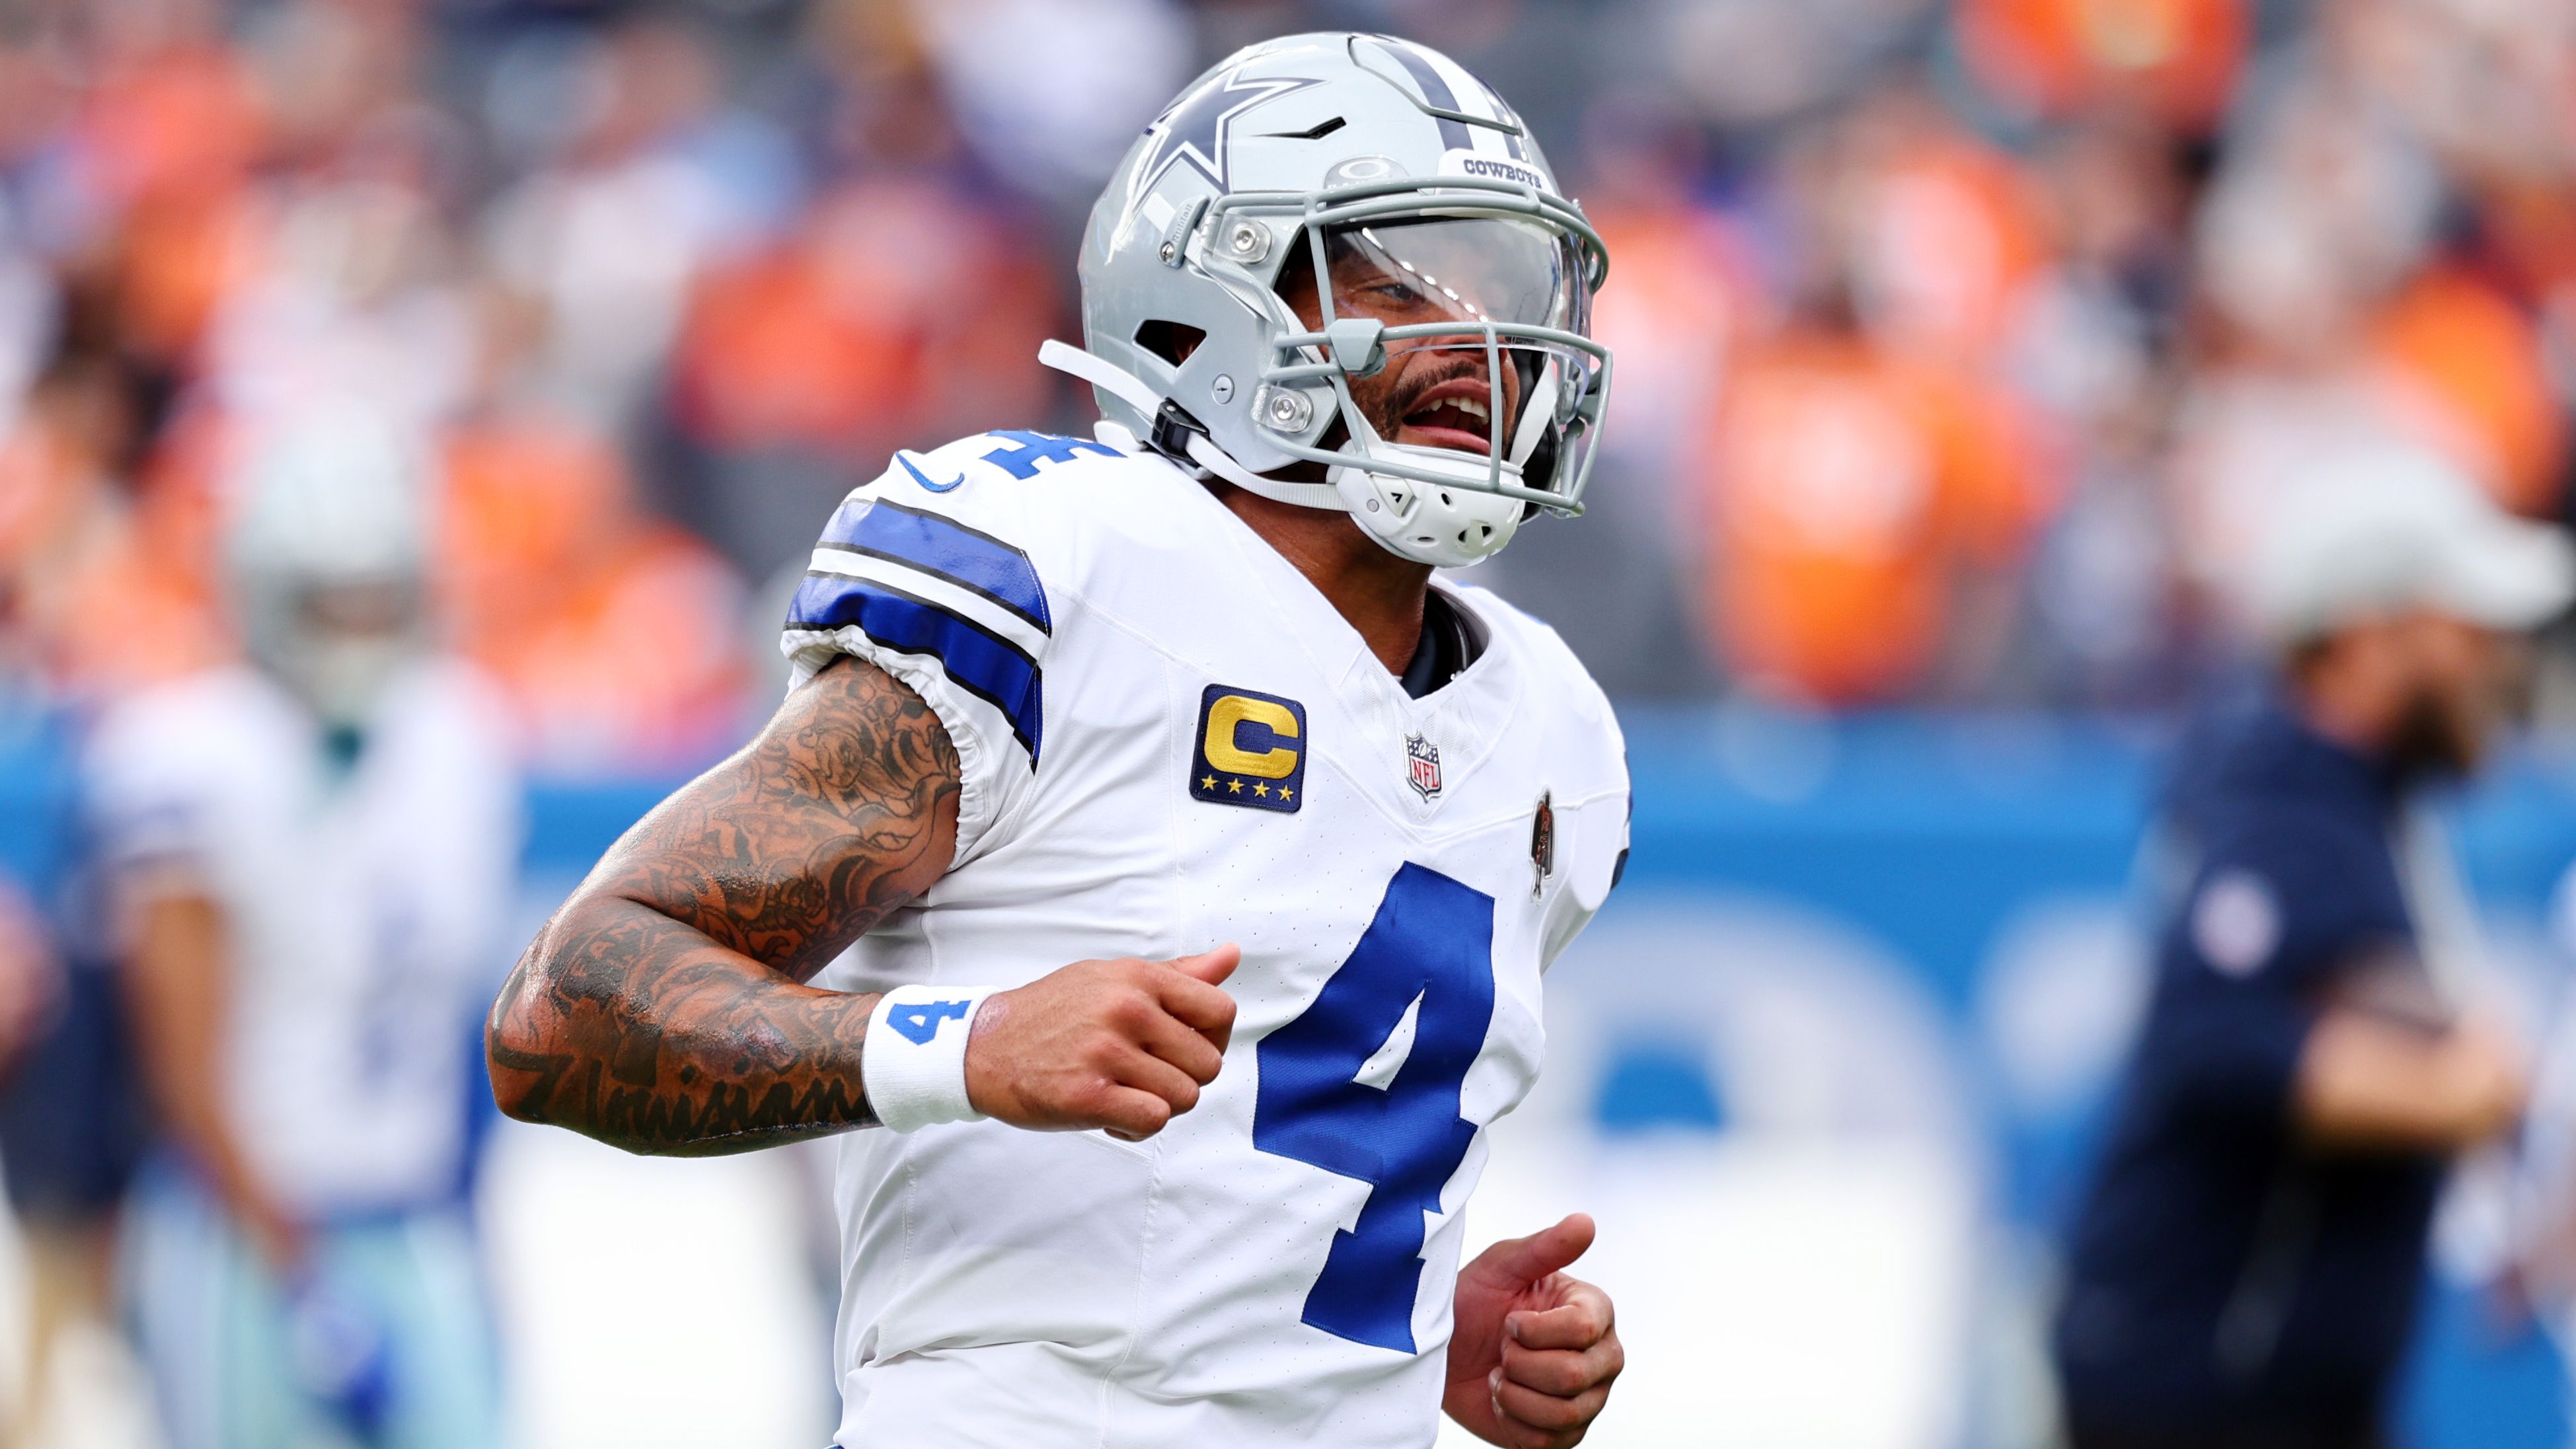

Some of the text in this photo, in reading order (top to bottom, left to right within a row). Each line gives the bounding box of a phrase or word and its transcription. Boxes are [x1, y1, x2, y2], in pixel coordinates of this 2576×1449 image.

[1463, 159, 1542, 189] COWBOYS
[1204, 694, 1299, 779] C
[1411, 759, 1439, 788] NFL
[886, 1000, 972, 1045] 4
[1253, 860, 1495, 1355] 4
